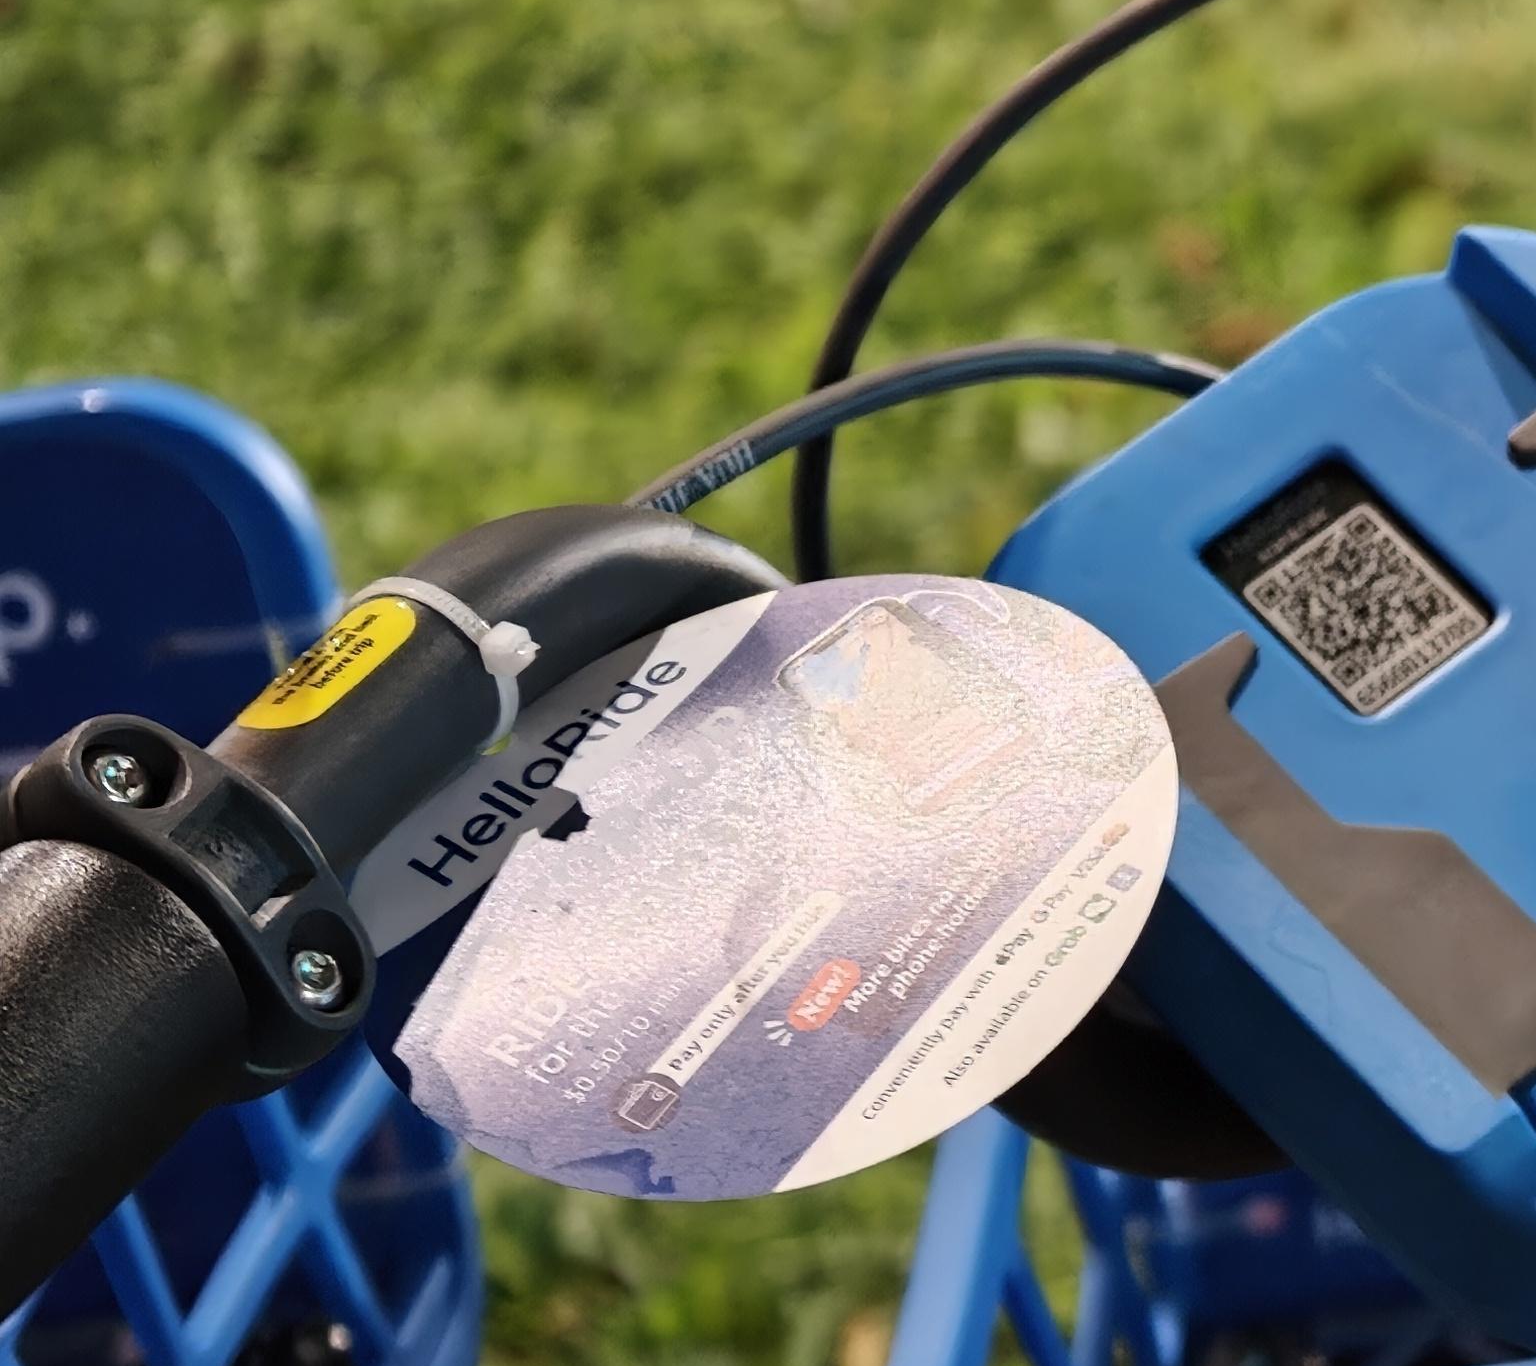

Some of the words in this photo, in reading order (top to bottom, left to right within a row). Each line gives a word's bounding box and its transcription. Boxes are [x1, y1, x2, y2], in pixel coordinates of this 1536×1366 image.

[308, 657, 352, 689] before
[349, 638, 375, 656] trip
[407, 661, 687, 887] HelloRide
[795, 964, 851, 1023] New!
[842, 963, 892, 1013] More
[888, 939, 943, 1001] phone
[668, 1039, 703, 1071] Pay
[700, 1004, 736, 1039] only
[734, 967, 768, 1003] after
[944, 1055, 974, 1087] Also
[973, 990, 1031, 1054] available
[1029, 969, 1048, 988] on
[1045, 925, 1087, 967] Grab
[521, 1042, 575, 1085] for
[862, 1033, 945, 1120] Conveniently
[941, 1001, 969, 1030] pay
[966, 969, 996, 1000] with
